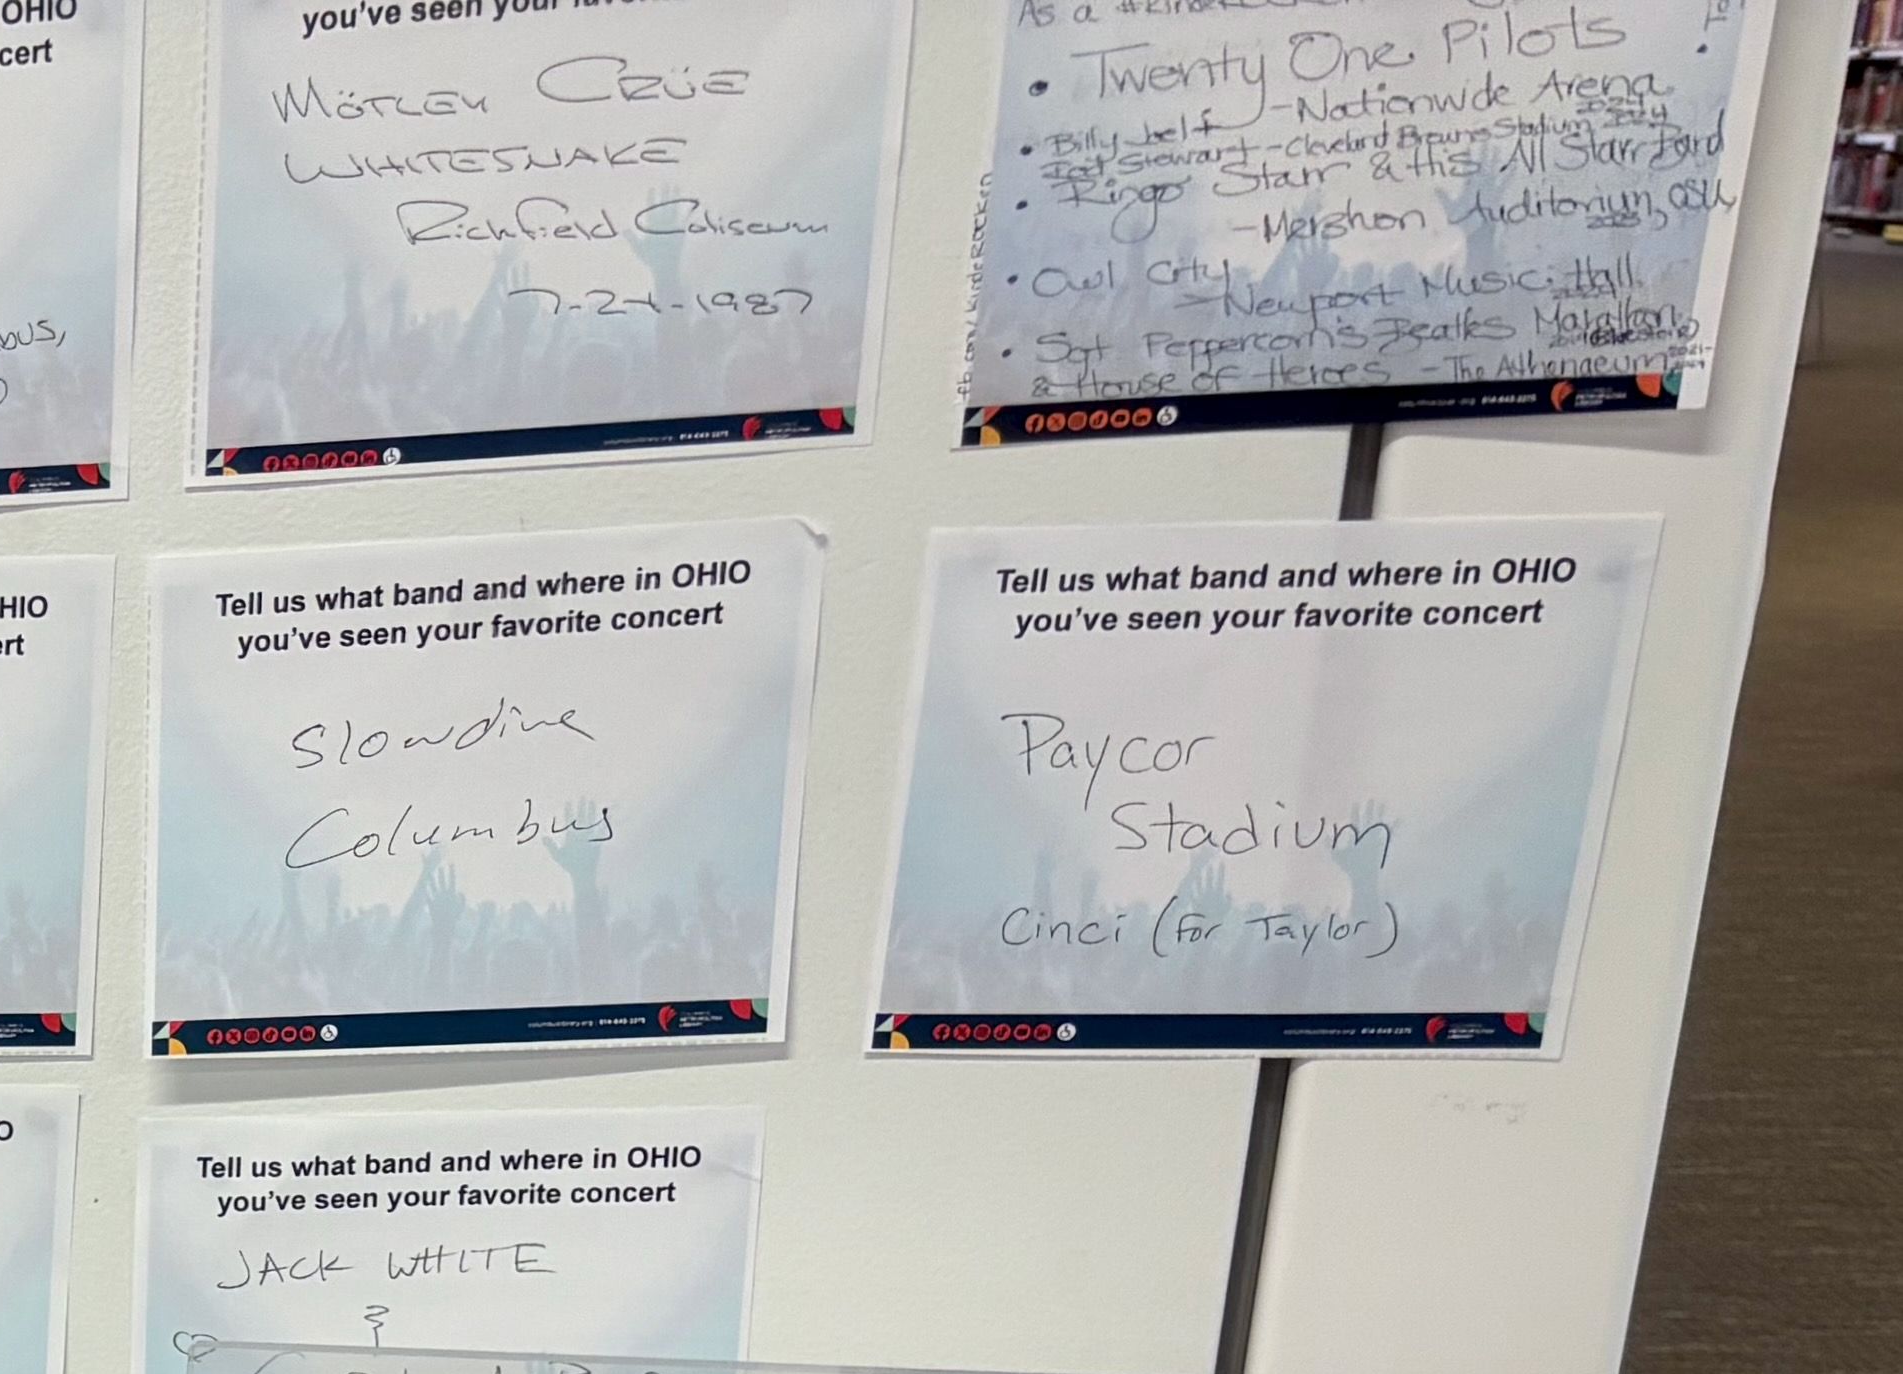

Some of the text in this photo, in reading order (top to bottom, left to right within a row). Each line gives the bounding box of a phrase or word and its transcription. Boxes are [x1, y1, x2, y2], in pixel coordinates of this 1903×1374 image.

[1072, 14, 1628, 123] Twenty One Pilots
[284, 138, 687, 184] WHITESNAKE
[1014, 599, 1544, 639] you've seen your favorite concert
[1001, 713, 1217, 811] Paycor
[1111, 802, 1392, 870] Stadium
[218, 1243, 556, 1290] JACK WHITE
